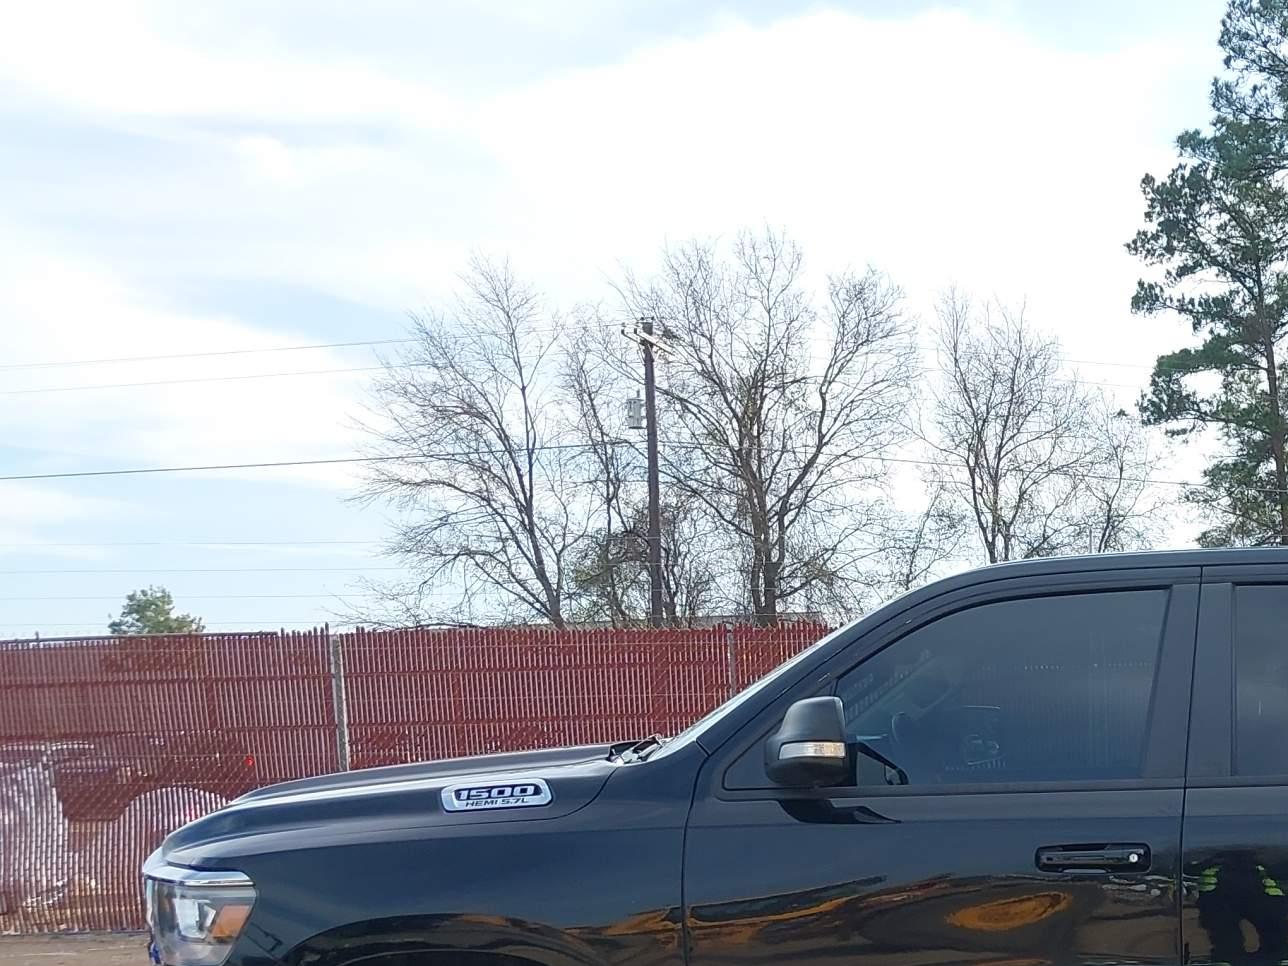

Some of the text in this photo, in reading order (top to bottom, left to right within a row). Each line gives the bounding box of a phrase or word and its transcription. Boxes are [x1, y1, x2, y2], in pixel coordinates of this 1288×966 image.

[458, 785, 536, 800] 1500
[465, 797, 529, 808] HEMI 5.7L
